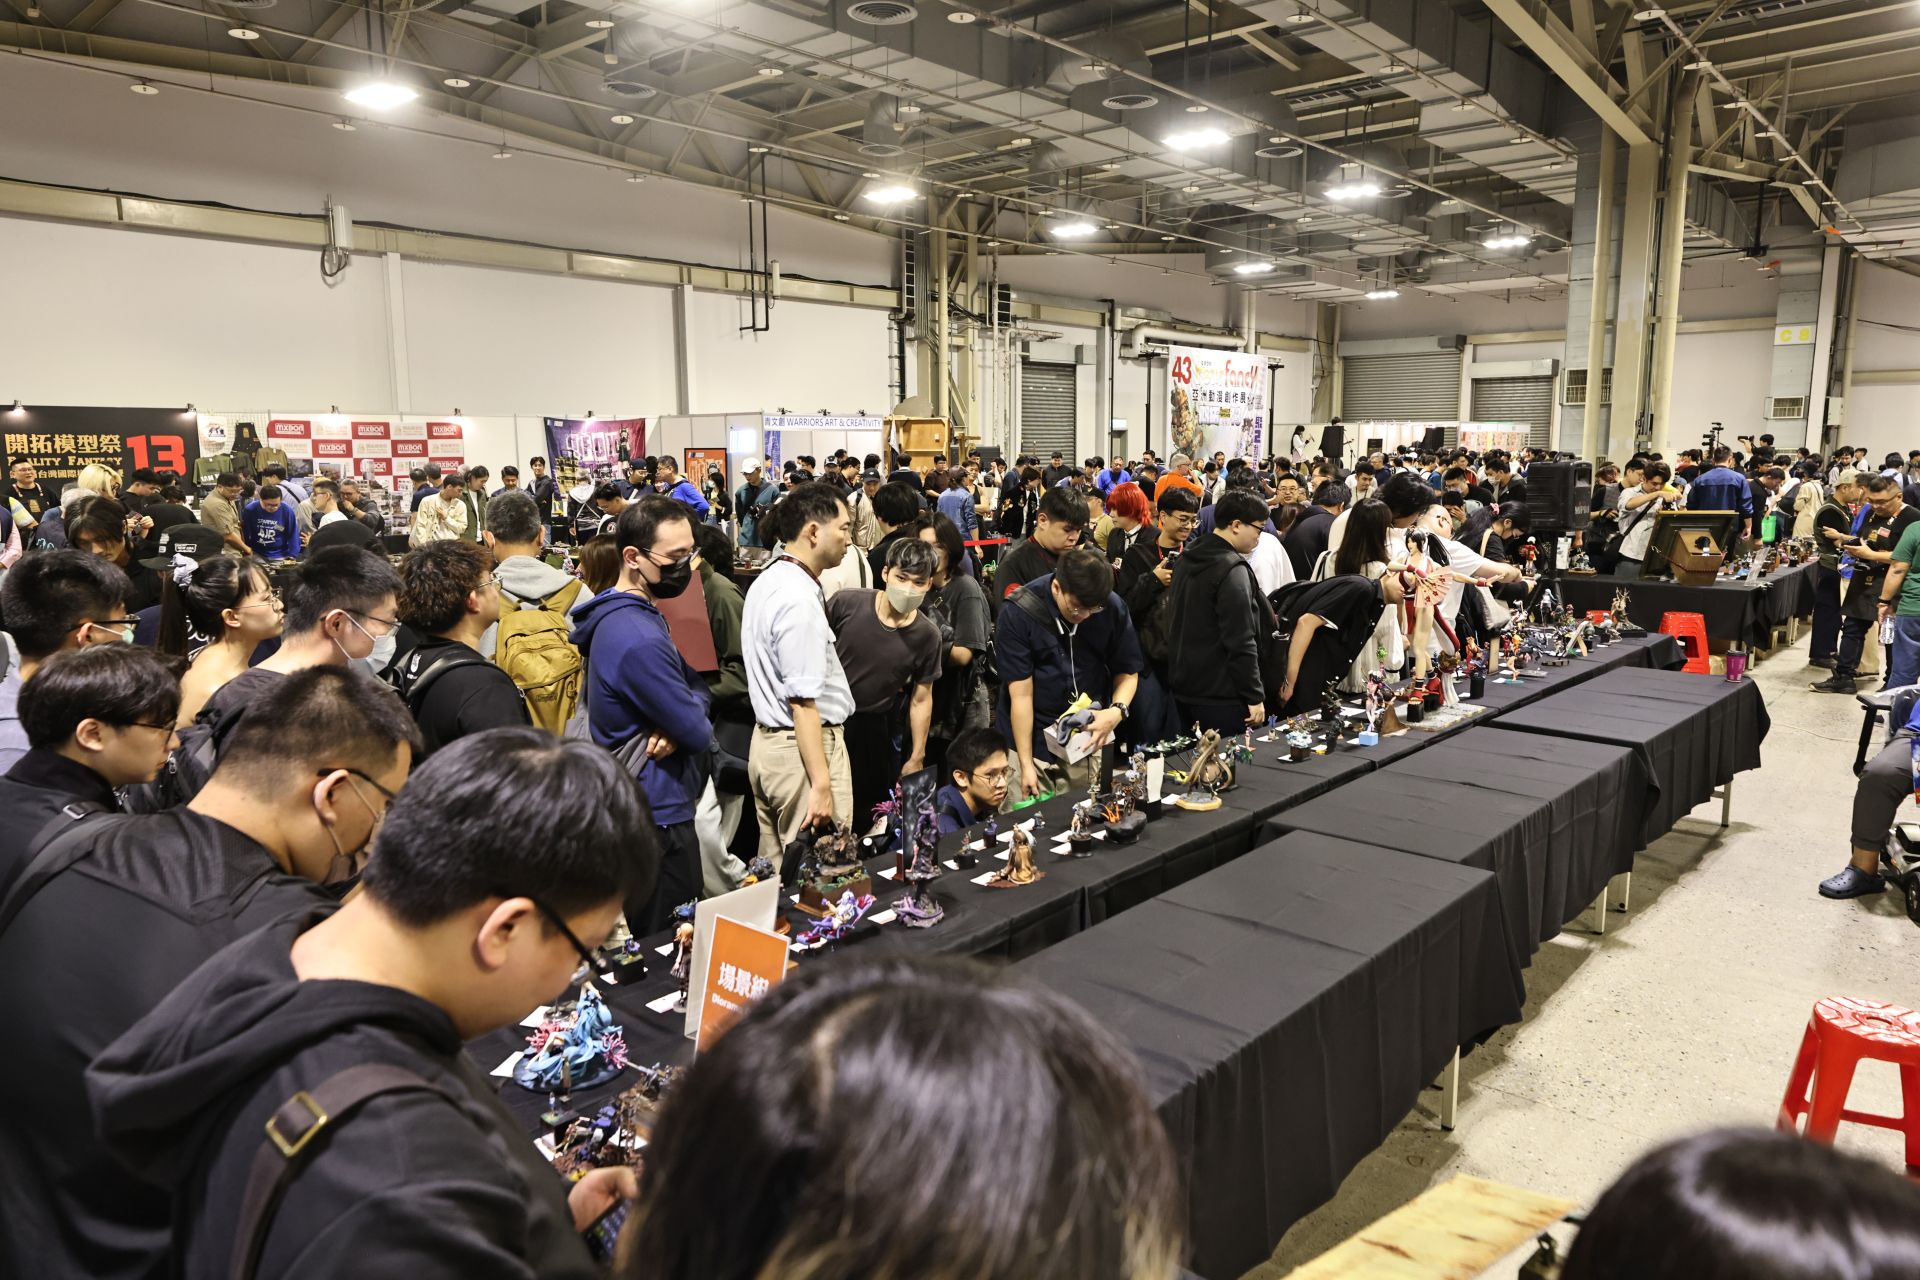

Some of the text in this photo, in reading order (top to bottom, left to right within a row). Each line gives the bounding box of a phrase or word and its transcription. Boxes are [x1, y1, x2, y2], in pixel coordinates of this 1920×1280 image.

[1172, 356, 1192, 384] 43
[786, 418, 823, 427] WARRIORS
[825, 418, 838, 427] ART
[839, 419, 845, 427] &
[846, 419, 881, 428] CREATIVITY
[5, 433, 122, 454] 開拓模型祭
[126, 434, 187, 476] 13
[717, 962, 769, 1001] 場景組
